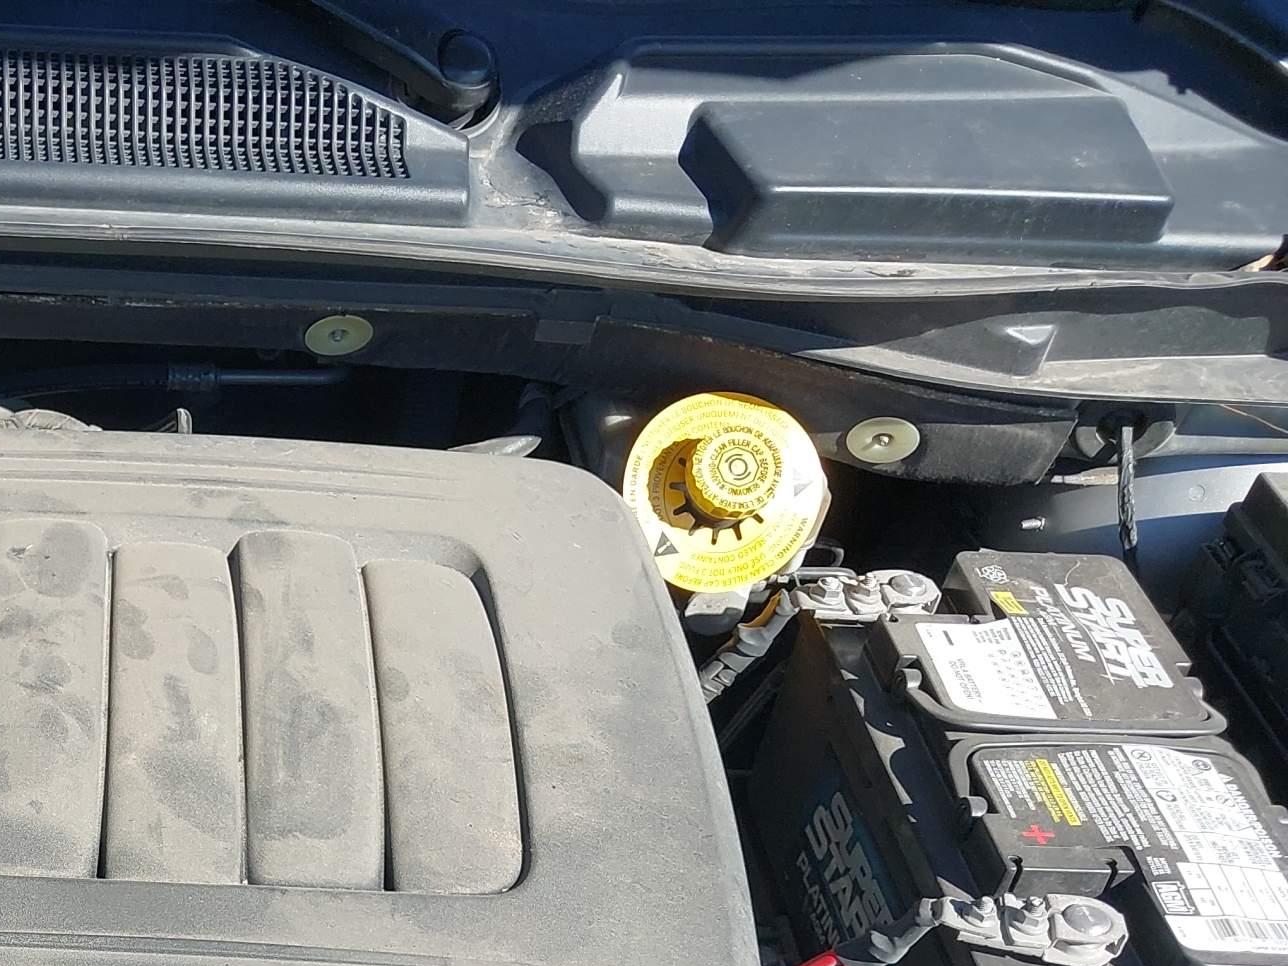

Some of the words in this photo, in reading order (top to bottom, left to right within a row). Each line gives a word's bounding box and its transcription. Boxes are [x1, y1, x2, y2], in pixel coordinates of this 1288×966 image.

[722, 425, 753, 435] BOUCHON
[1029, 585, 1097, 664] PLATINUM
[1054, 583, 1128, 683] START
[1101, 596, 1175, 688] SUPER
[804, 805, 869, 939] STAR
[1158, 883, 1191, 914] AGM
